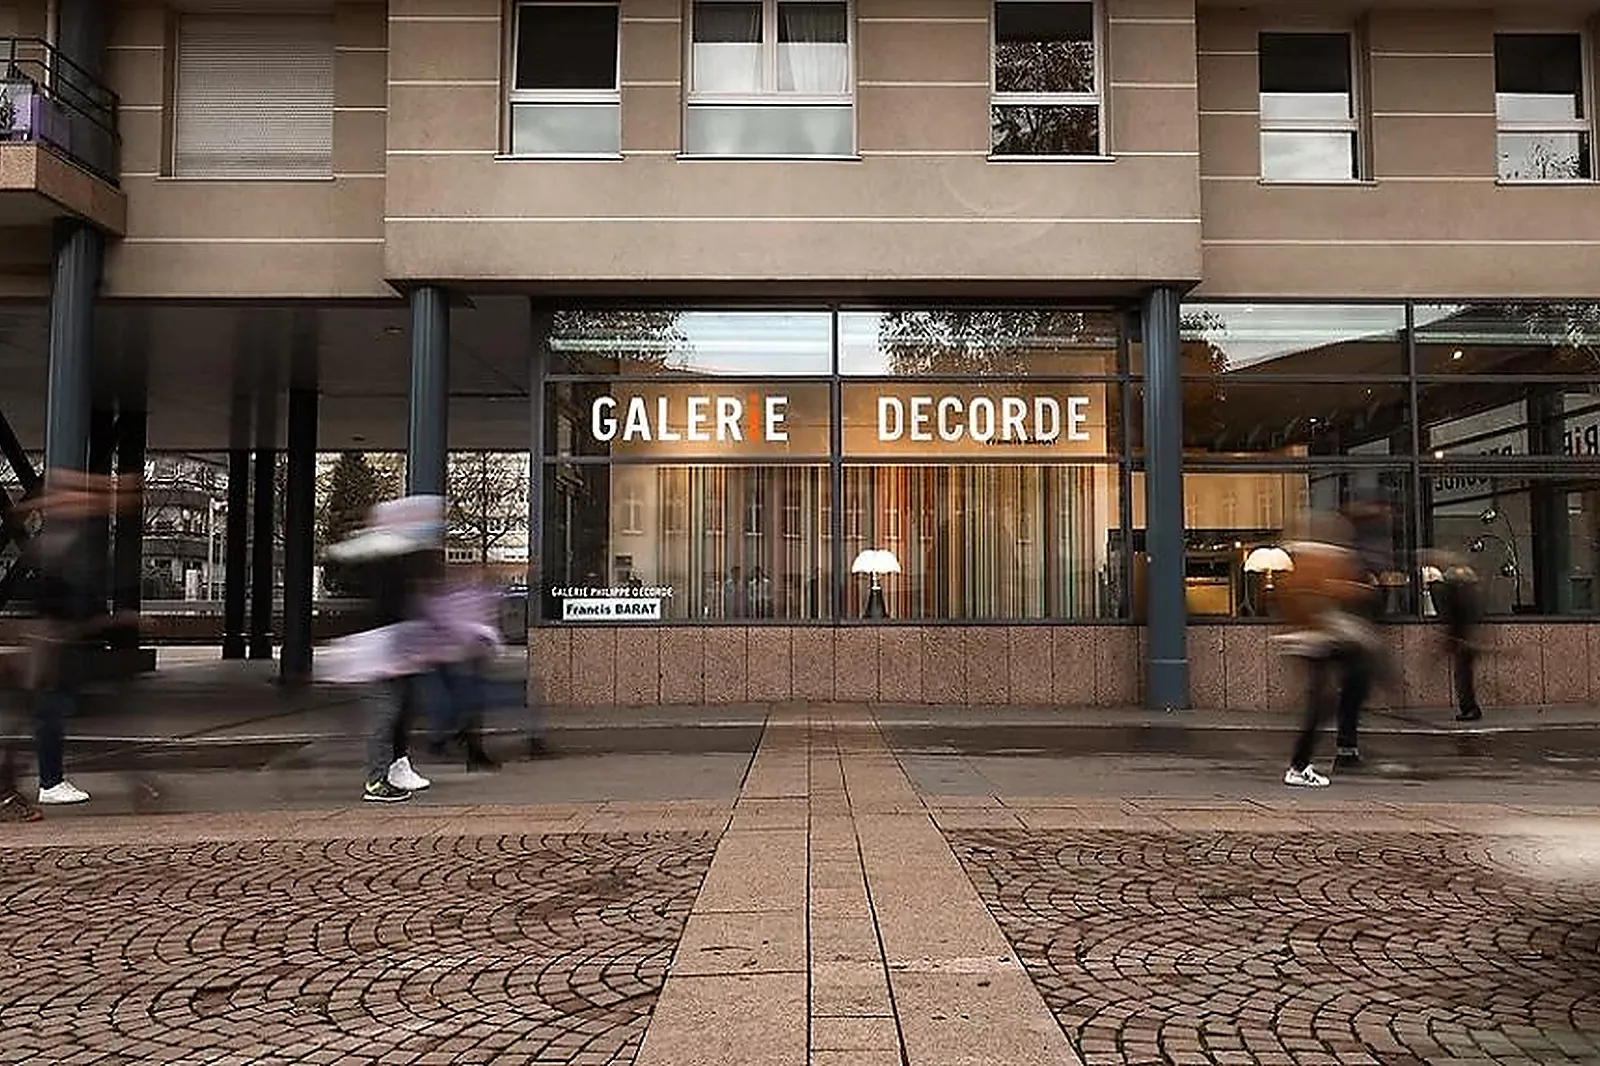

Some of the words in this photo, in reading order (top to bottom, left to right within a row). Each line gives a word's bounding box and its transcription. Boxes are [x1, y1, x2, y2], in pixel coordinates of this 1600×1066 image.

[877, 396, 1090, 441] DECORDE
[566, 604, 611, 615] Francis
[615, 604, 657, 615] BARAT
